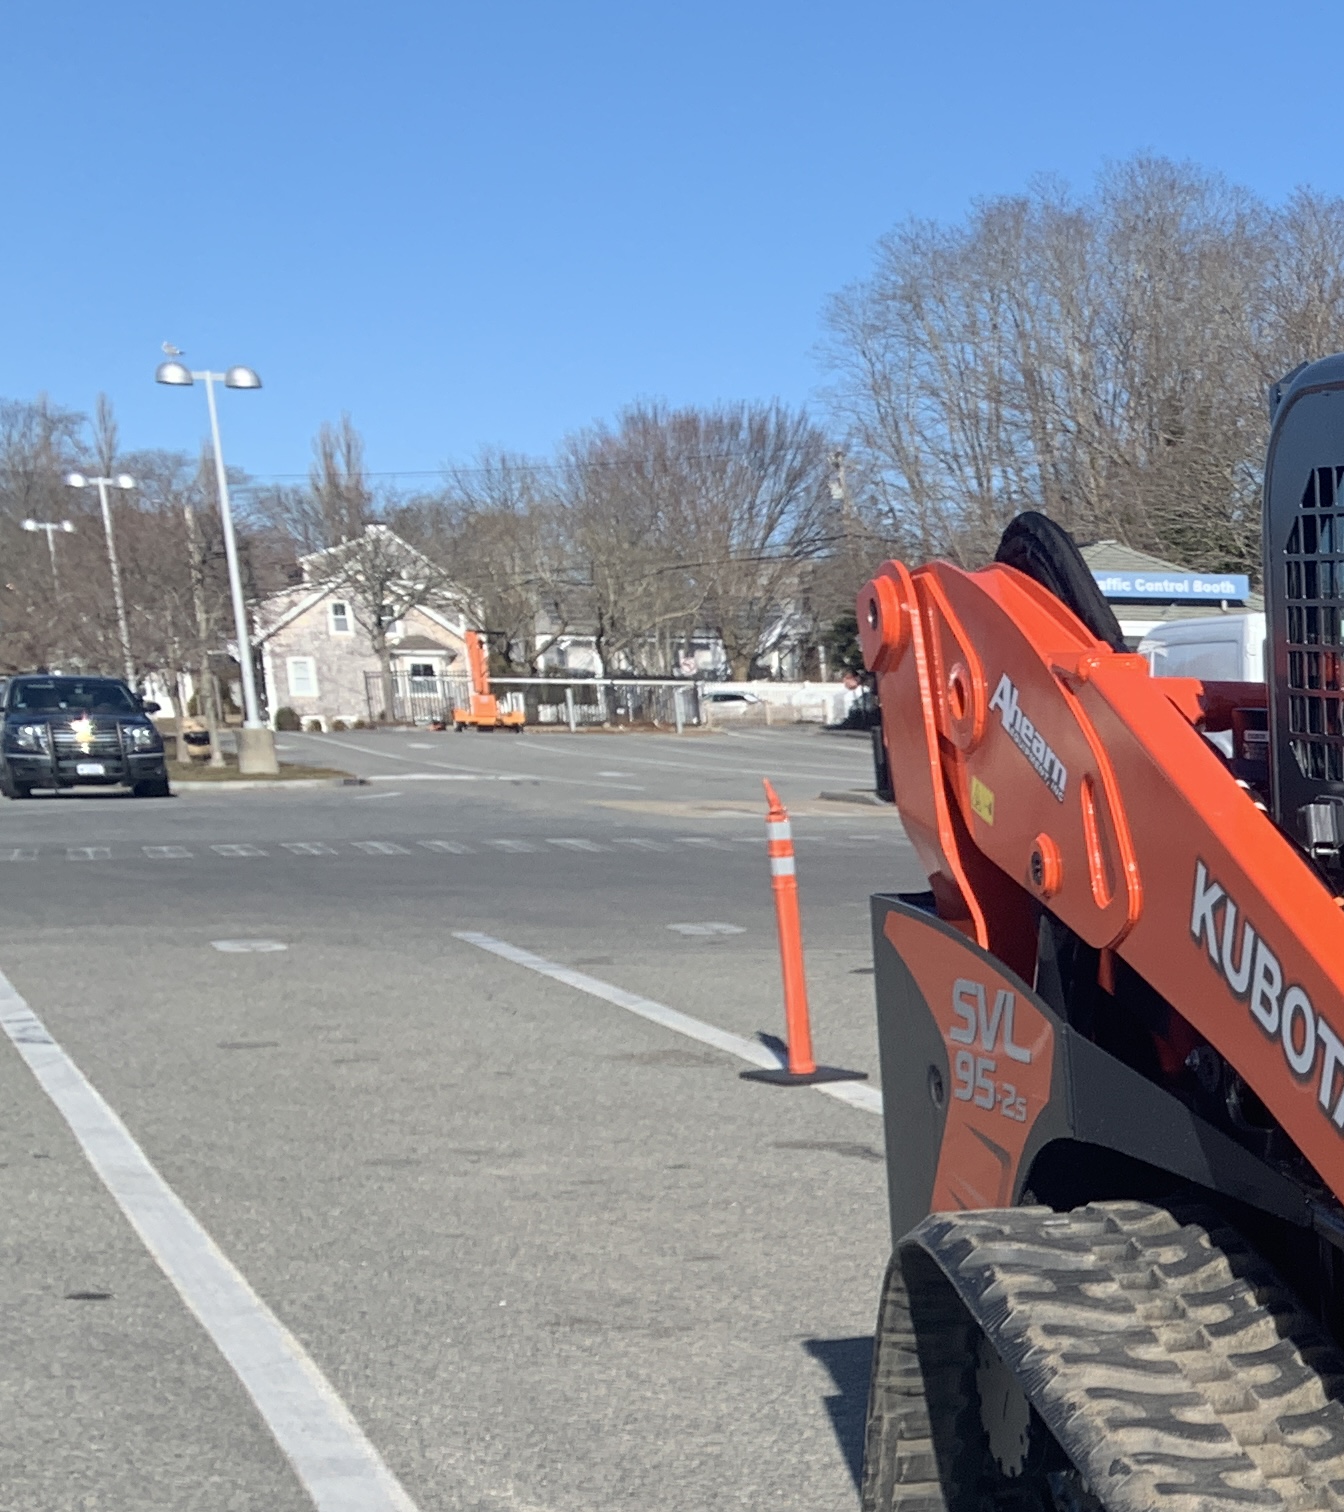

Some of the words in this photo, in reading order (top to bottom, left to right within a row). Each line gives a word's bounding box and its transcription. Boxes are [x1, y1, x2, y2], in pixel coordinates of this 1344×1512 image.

[1097, 577, 1132, 592] affic
[1134, 578, 1189, 593] Control
[1193, 580, 1236, 594] Booth
[988, 672, 1067, 793] Ahearn
[949, 978, 1032, 1064] SVL
